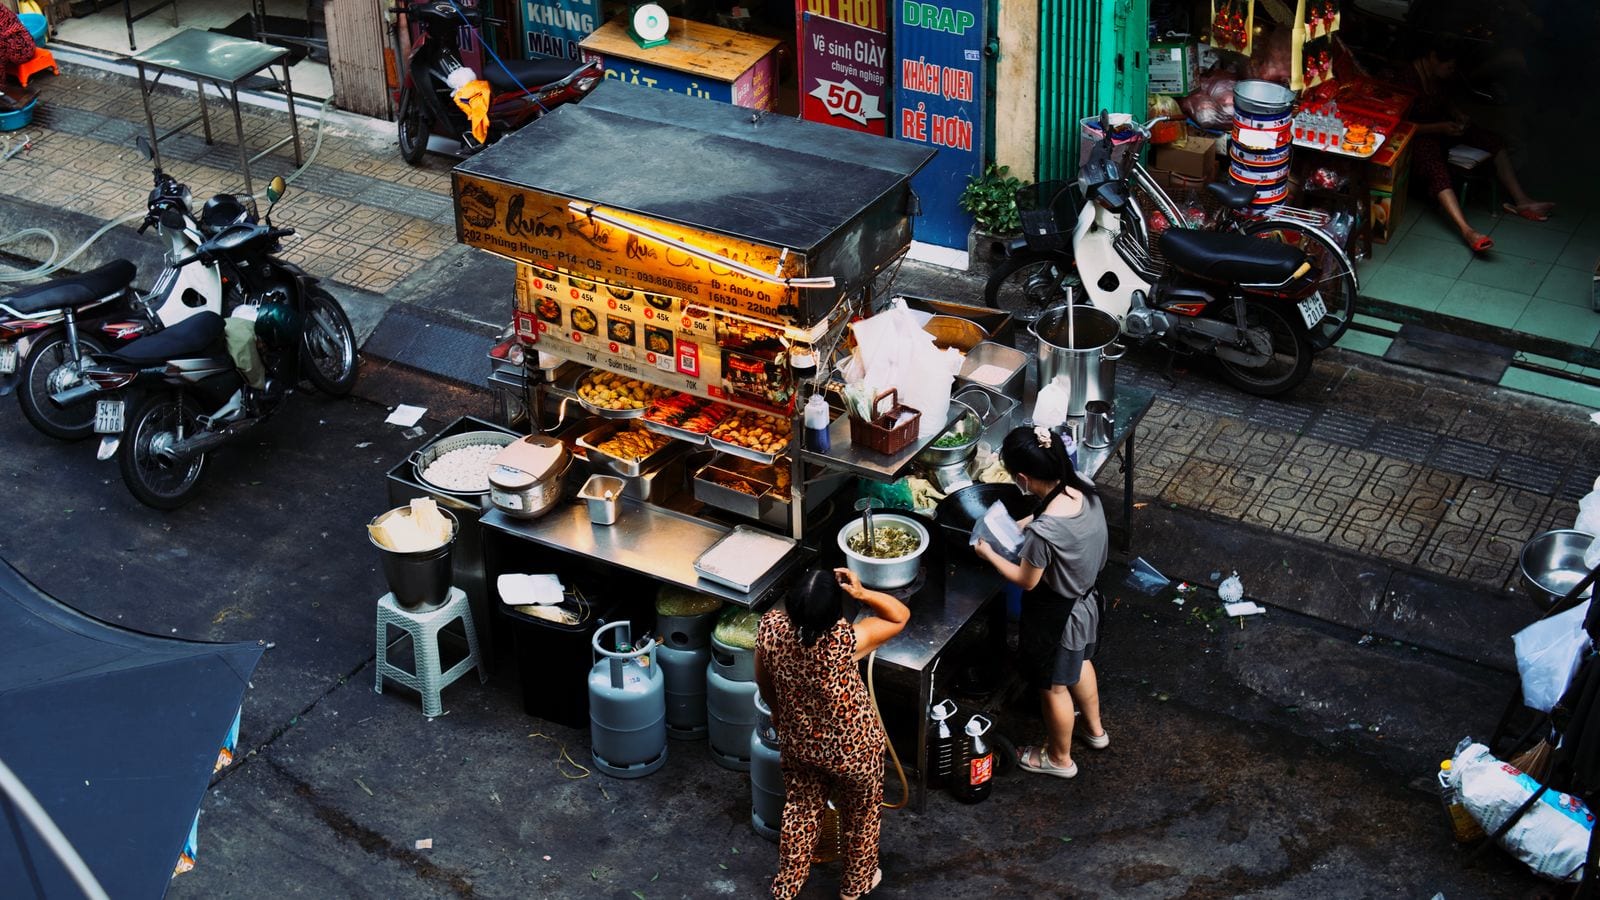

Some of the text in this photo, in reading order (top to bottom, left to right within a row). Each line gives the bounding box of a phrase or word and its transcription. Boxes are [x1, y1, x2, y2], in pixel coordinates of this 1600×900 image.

[527, 1, 594, 33] KHỦNG
[902, 0, 975, 36] DRAP
[527, 29, 564, 61] MÀN
[812, 33, 887, 69] Vệ sinh GIÀY
[831, 60, 885, 86] chuyên nghiệp
[902, 56, 973, 103] KHÁCH QUEN
[826, 83, 867, 118] 50k
[902, 102, 973, 152] RẺ HƠN
[464, 228, 482, 242] 202
[484, 233, 518, 252] Phùng
[519, 242, 549, 260] Hưng
[557, 251, 578, 266] P14
[586, 258, 603, 271] Q5
[545, 282, 558, 293] 45k
[581, 292, 594, 303] 45k
[729, 284, 755, 300] Andy
[757, 290, 772, 303] On
[618, 303, 632, 313] 45k
[656, 311, 670, 323] 45k
[708, 291, 738, 308] 16h30
[747, 302, 778, 317] 22h00
[694, 321, 708, 331] 50k
[99, 417, 120, 432] 7106
